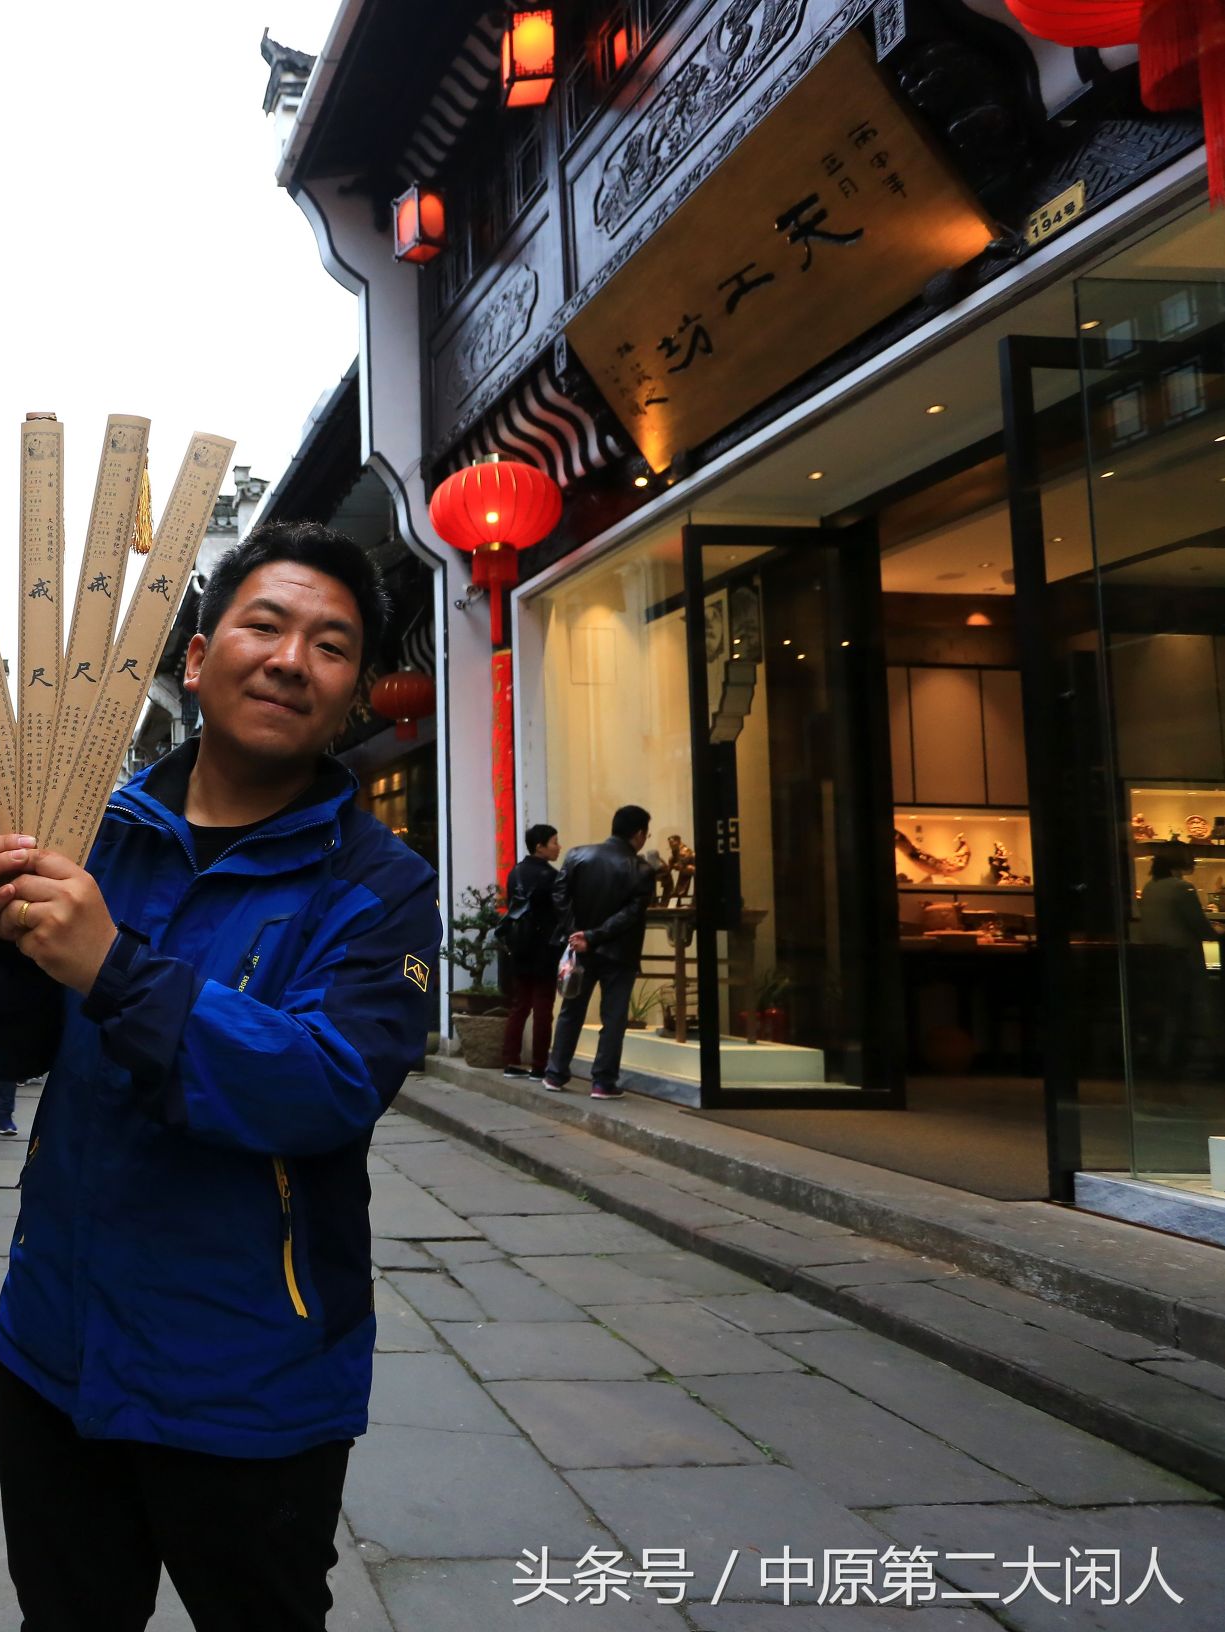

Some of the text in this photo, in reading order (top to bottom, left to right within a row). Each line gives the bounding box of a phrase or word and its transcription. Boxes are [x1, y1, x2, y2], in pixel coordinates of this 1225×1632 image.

[1031, 200, 1076, 239] 194号
[657, 192, 864, 374] 天工坊
